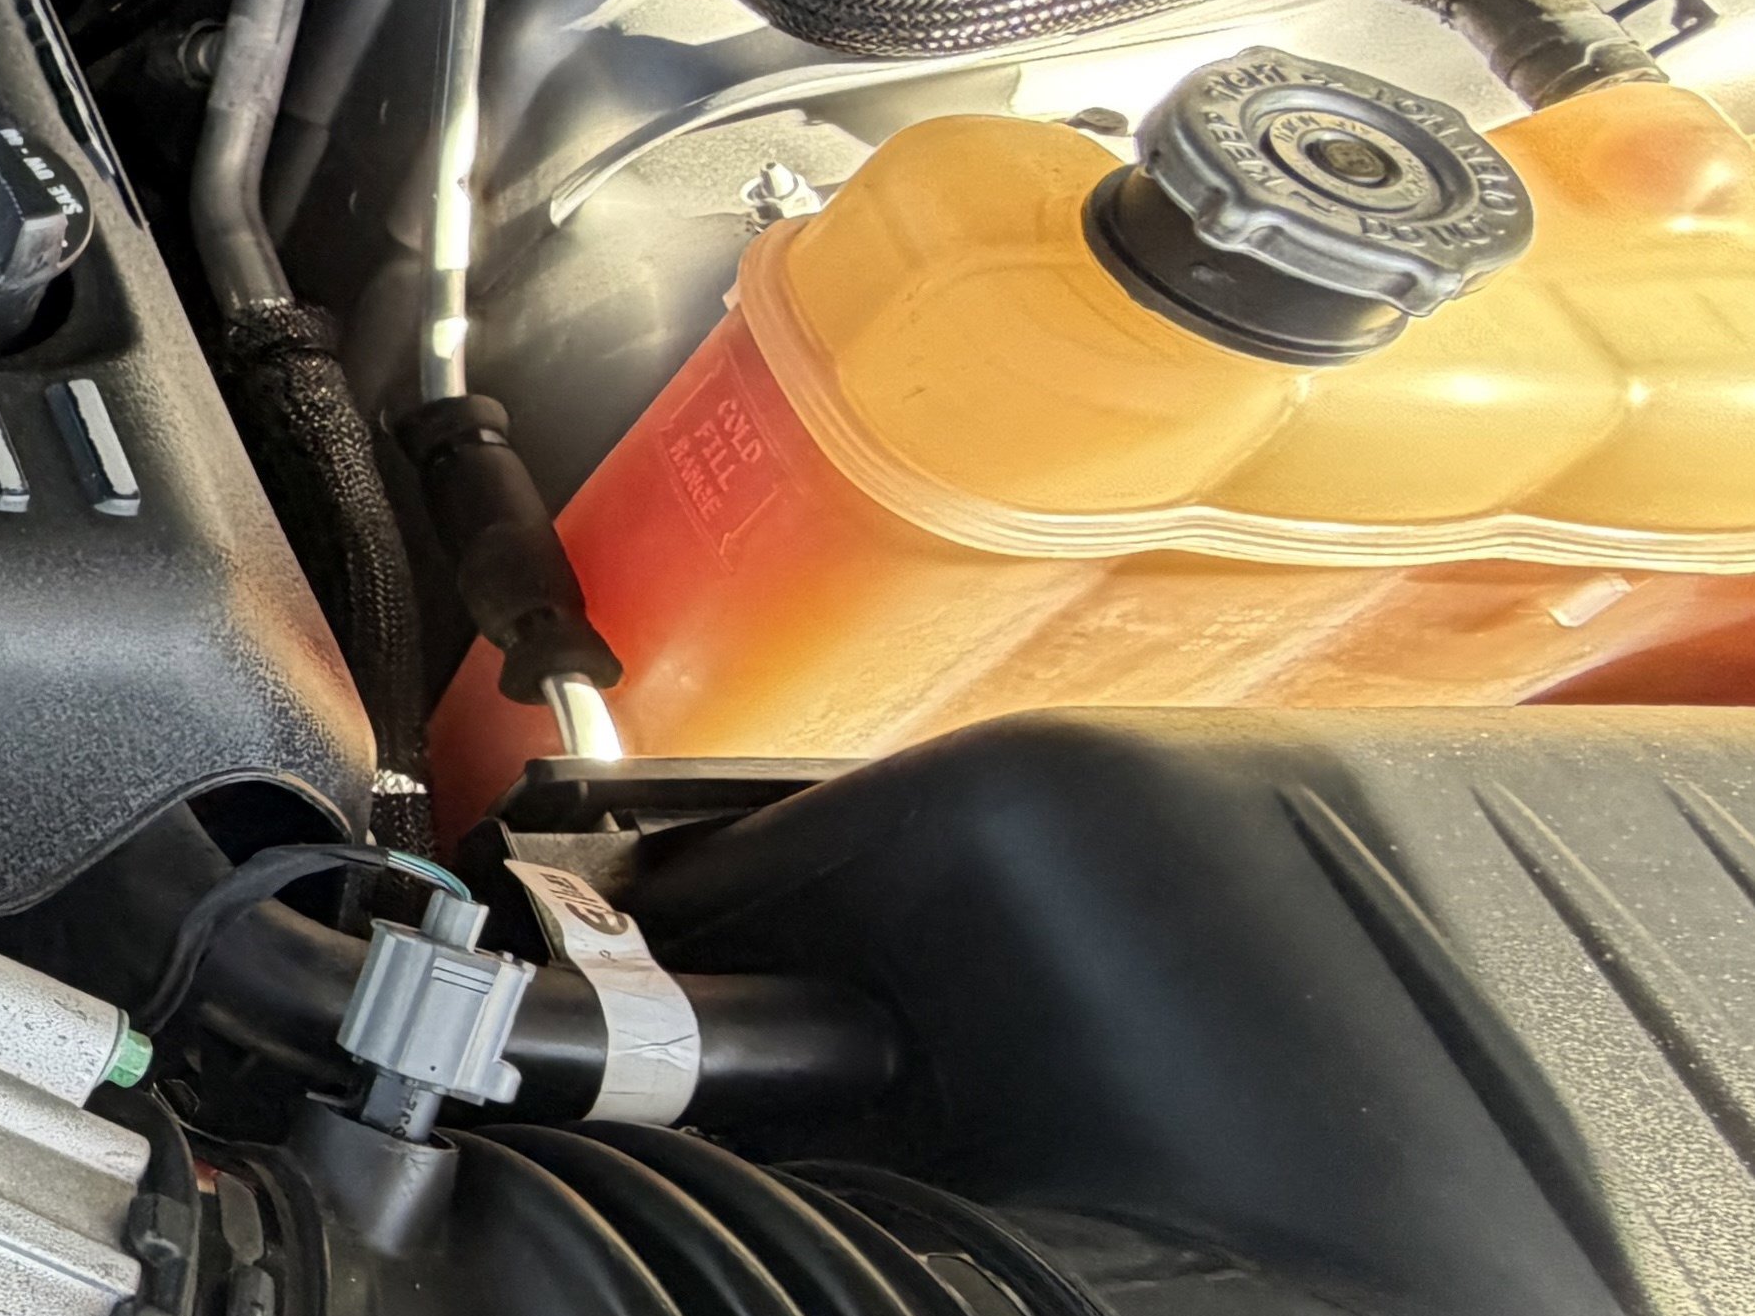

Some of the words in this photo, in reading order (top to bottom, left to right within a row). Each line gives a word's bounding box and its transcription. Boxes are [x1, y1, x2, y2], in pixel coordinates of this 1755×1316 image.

[46, 183, 84, 216] SAE
[693, 423, 739, 492] FILL
[716, 398, 762, 465] COLD
[670, 437, 724, 522] RANGE
